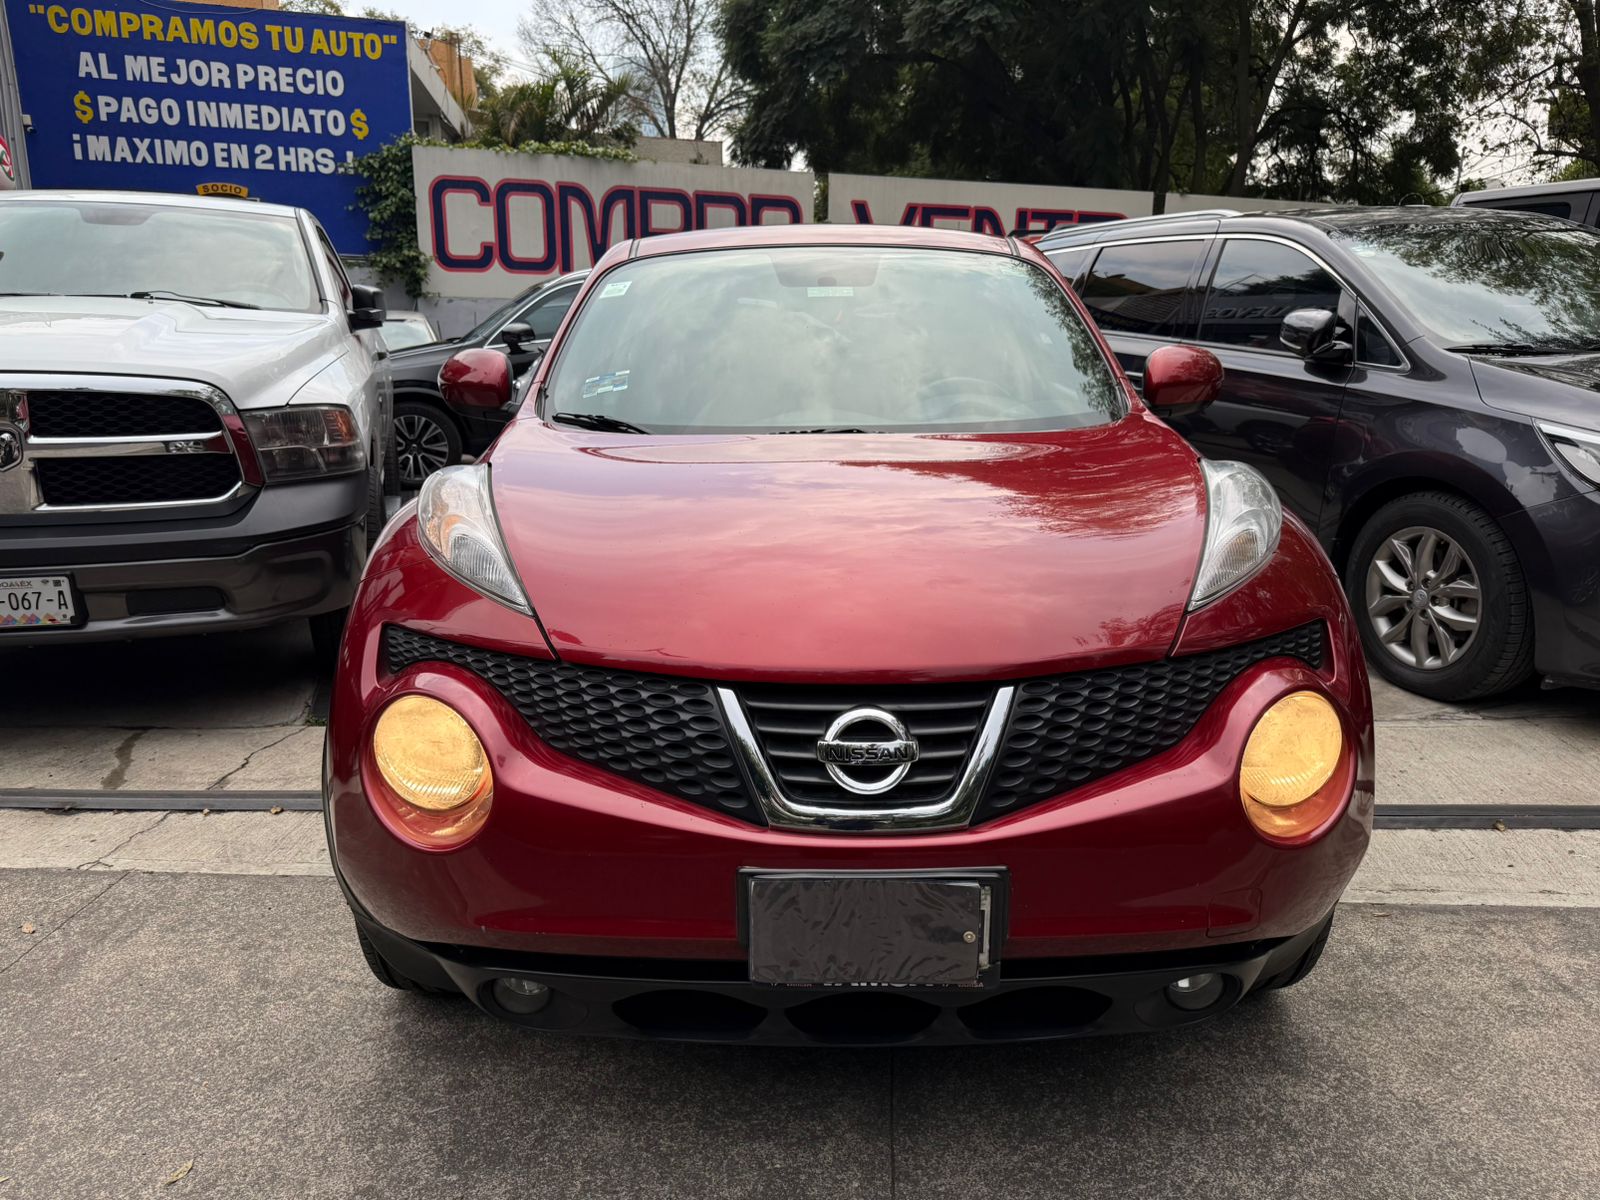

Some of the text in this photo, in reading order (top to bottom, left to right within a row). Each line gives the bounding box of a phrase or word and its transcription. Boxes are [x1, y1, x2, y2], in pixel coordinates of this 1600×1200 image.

[29, 5, 398, 61] "COMPRAMOS TU AUTO"
[78, 51, 344, 97] AL MEJOR PRECIO
[97, 95, 180, 126] PAGO
[187, 101, 346, 136] INMEDIATO
[214, 142, 249, 169] EN
[255, 143, 275, 170] 2
[202, 183, 242, 194] SOCIO
[828, 747, 909, 761] NISSAN
